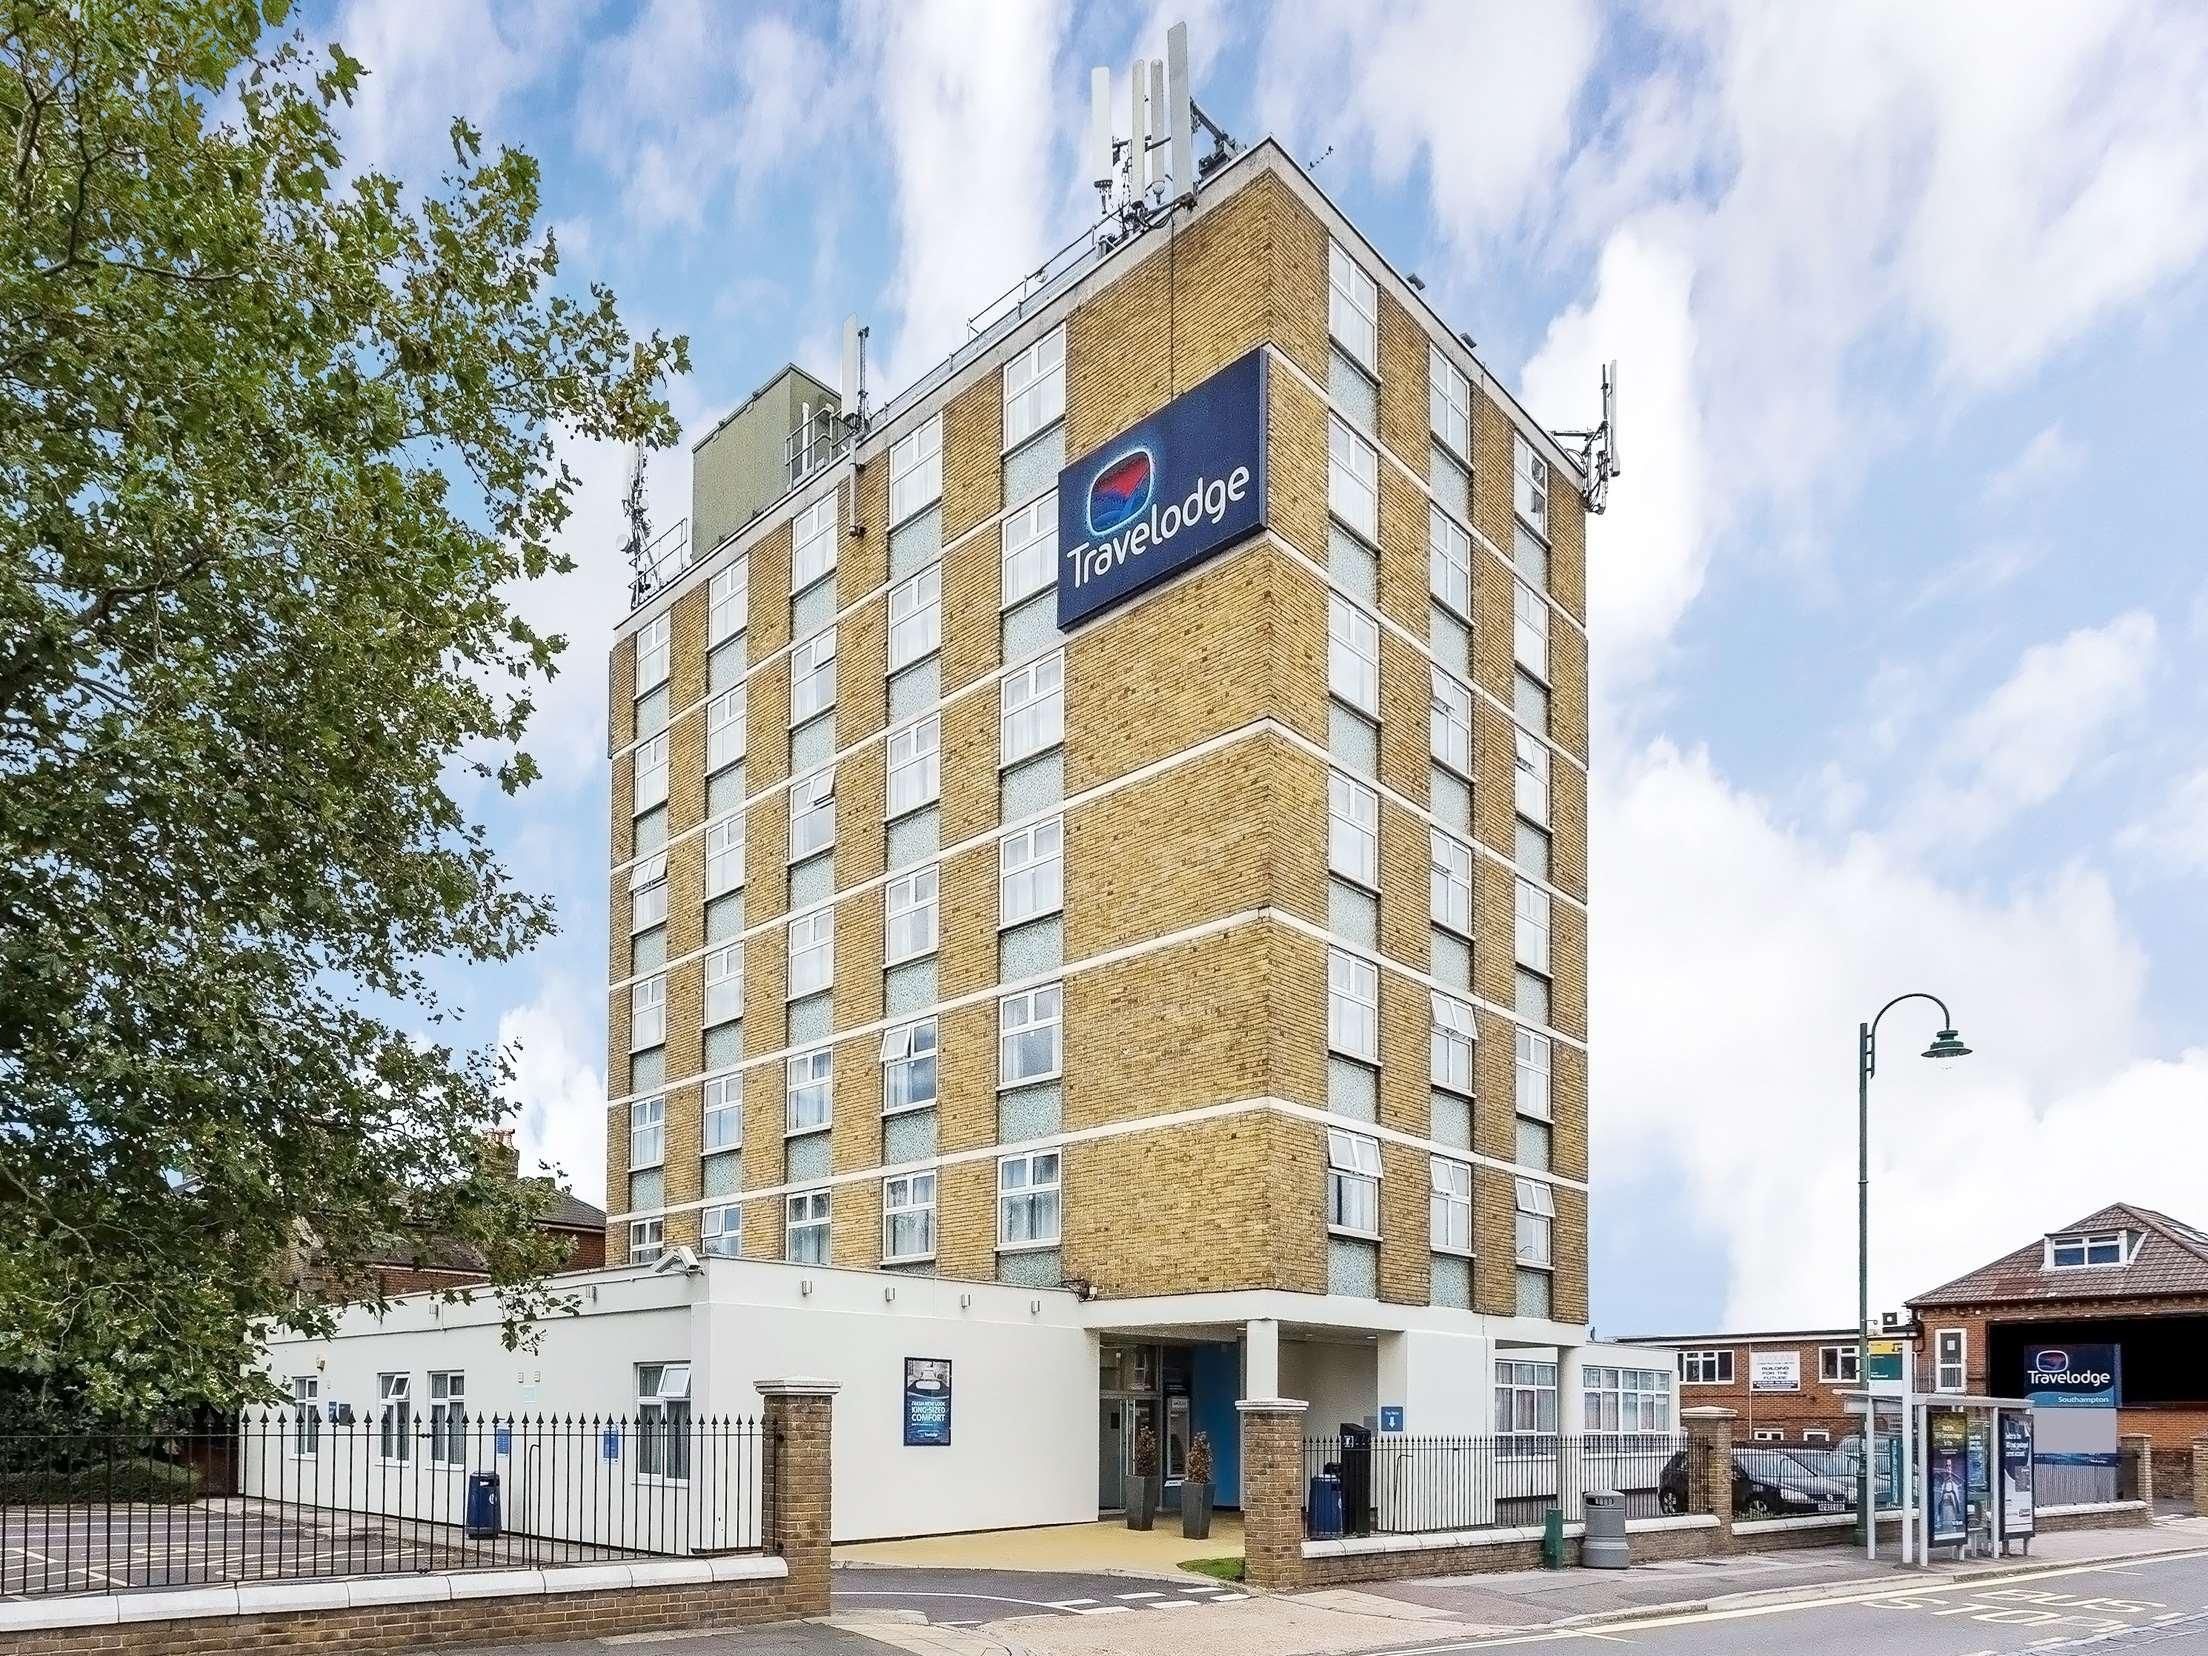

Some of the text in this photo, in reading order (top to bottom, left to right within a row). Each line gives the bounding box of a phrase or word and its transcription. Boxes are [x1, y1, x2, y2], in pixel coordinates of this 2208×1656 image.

[1066, 466, 1250, 588] Travelodge
[2027, 1370, 2111, 1387] Travelodge
[2057, 1396, 2109, 1404] Southampton
[911, 1406, 946, 1414] KING-SIZED
[911, 1413, 946, 1422] COMFORT
[1970, 1589, 2168, 1613] BUS
[1859, 1597, 2133, 1633] STOP
